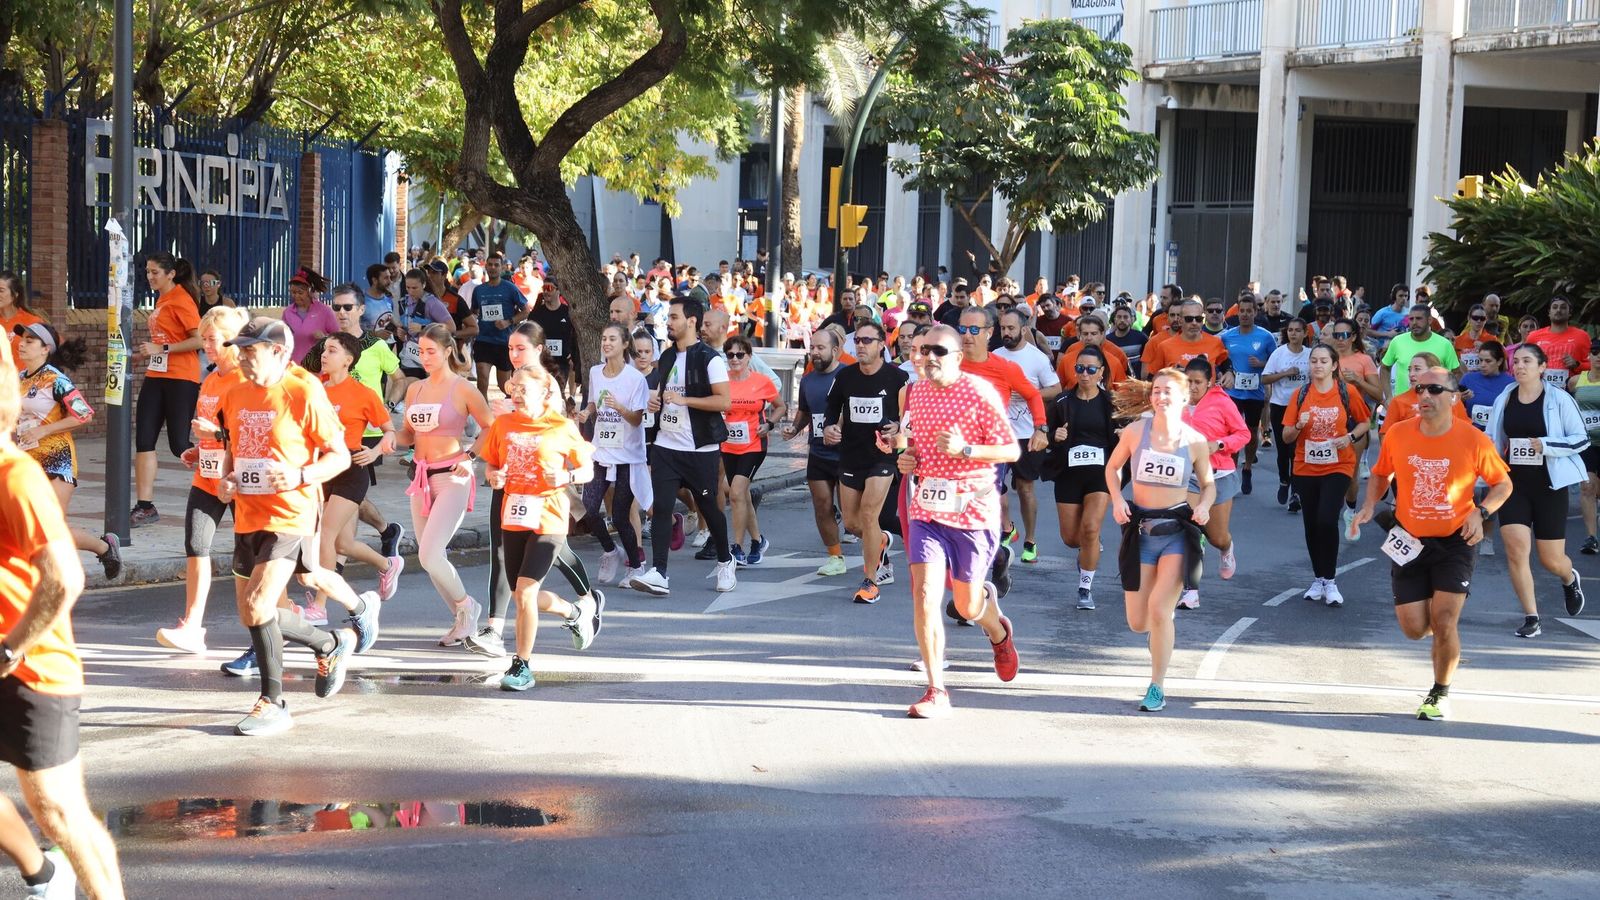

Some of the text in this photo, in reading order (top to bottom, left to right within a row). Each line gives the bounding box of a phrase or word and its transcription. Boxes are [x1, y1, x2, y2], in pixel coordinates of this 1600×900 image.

[853, 405, 880, 415] 1072
[410, 412, 432, 424] 697
[1073, 451, 1097, 459] 881
[1309, 449, 1332, 457] 443
[1513, 447, 1536, 457] 269
[1144, 462, 1176, 477] 210
[241, 472, 260, 484] 86
[922, 489, 947, 501] 670
[510, 505, 528, 517] 59
[1387, 533, 1412, 556] 795
